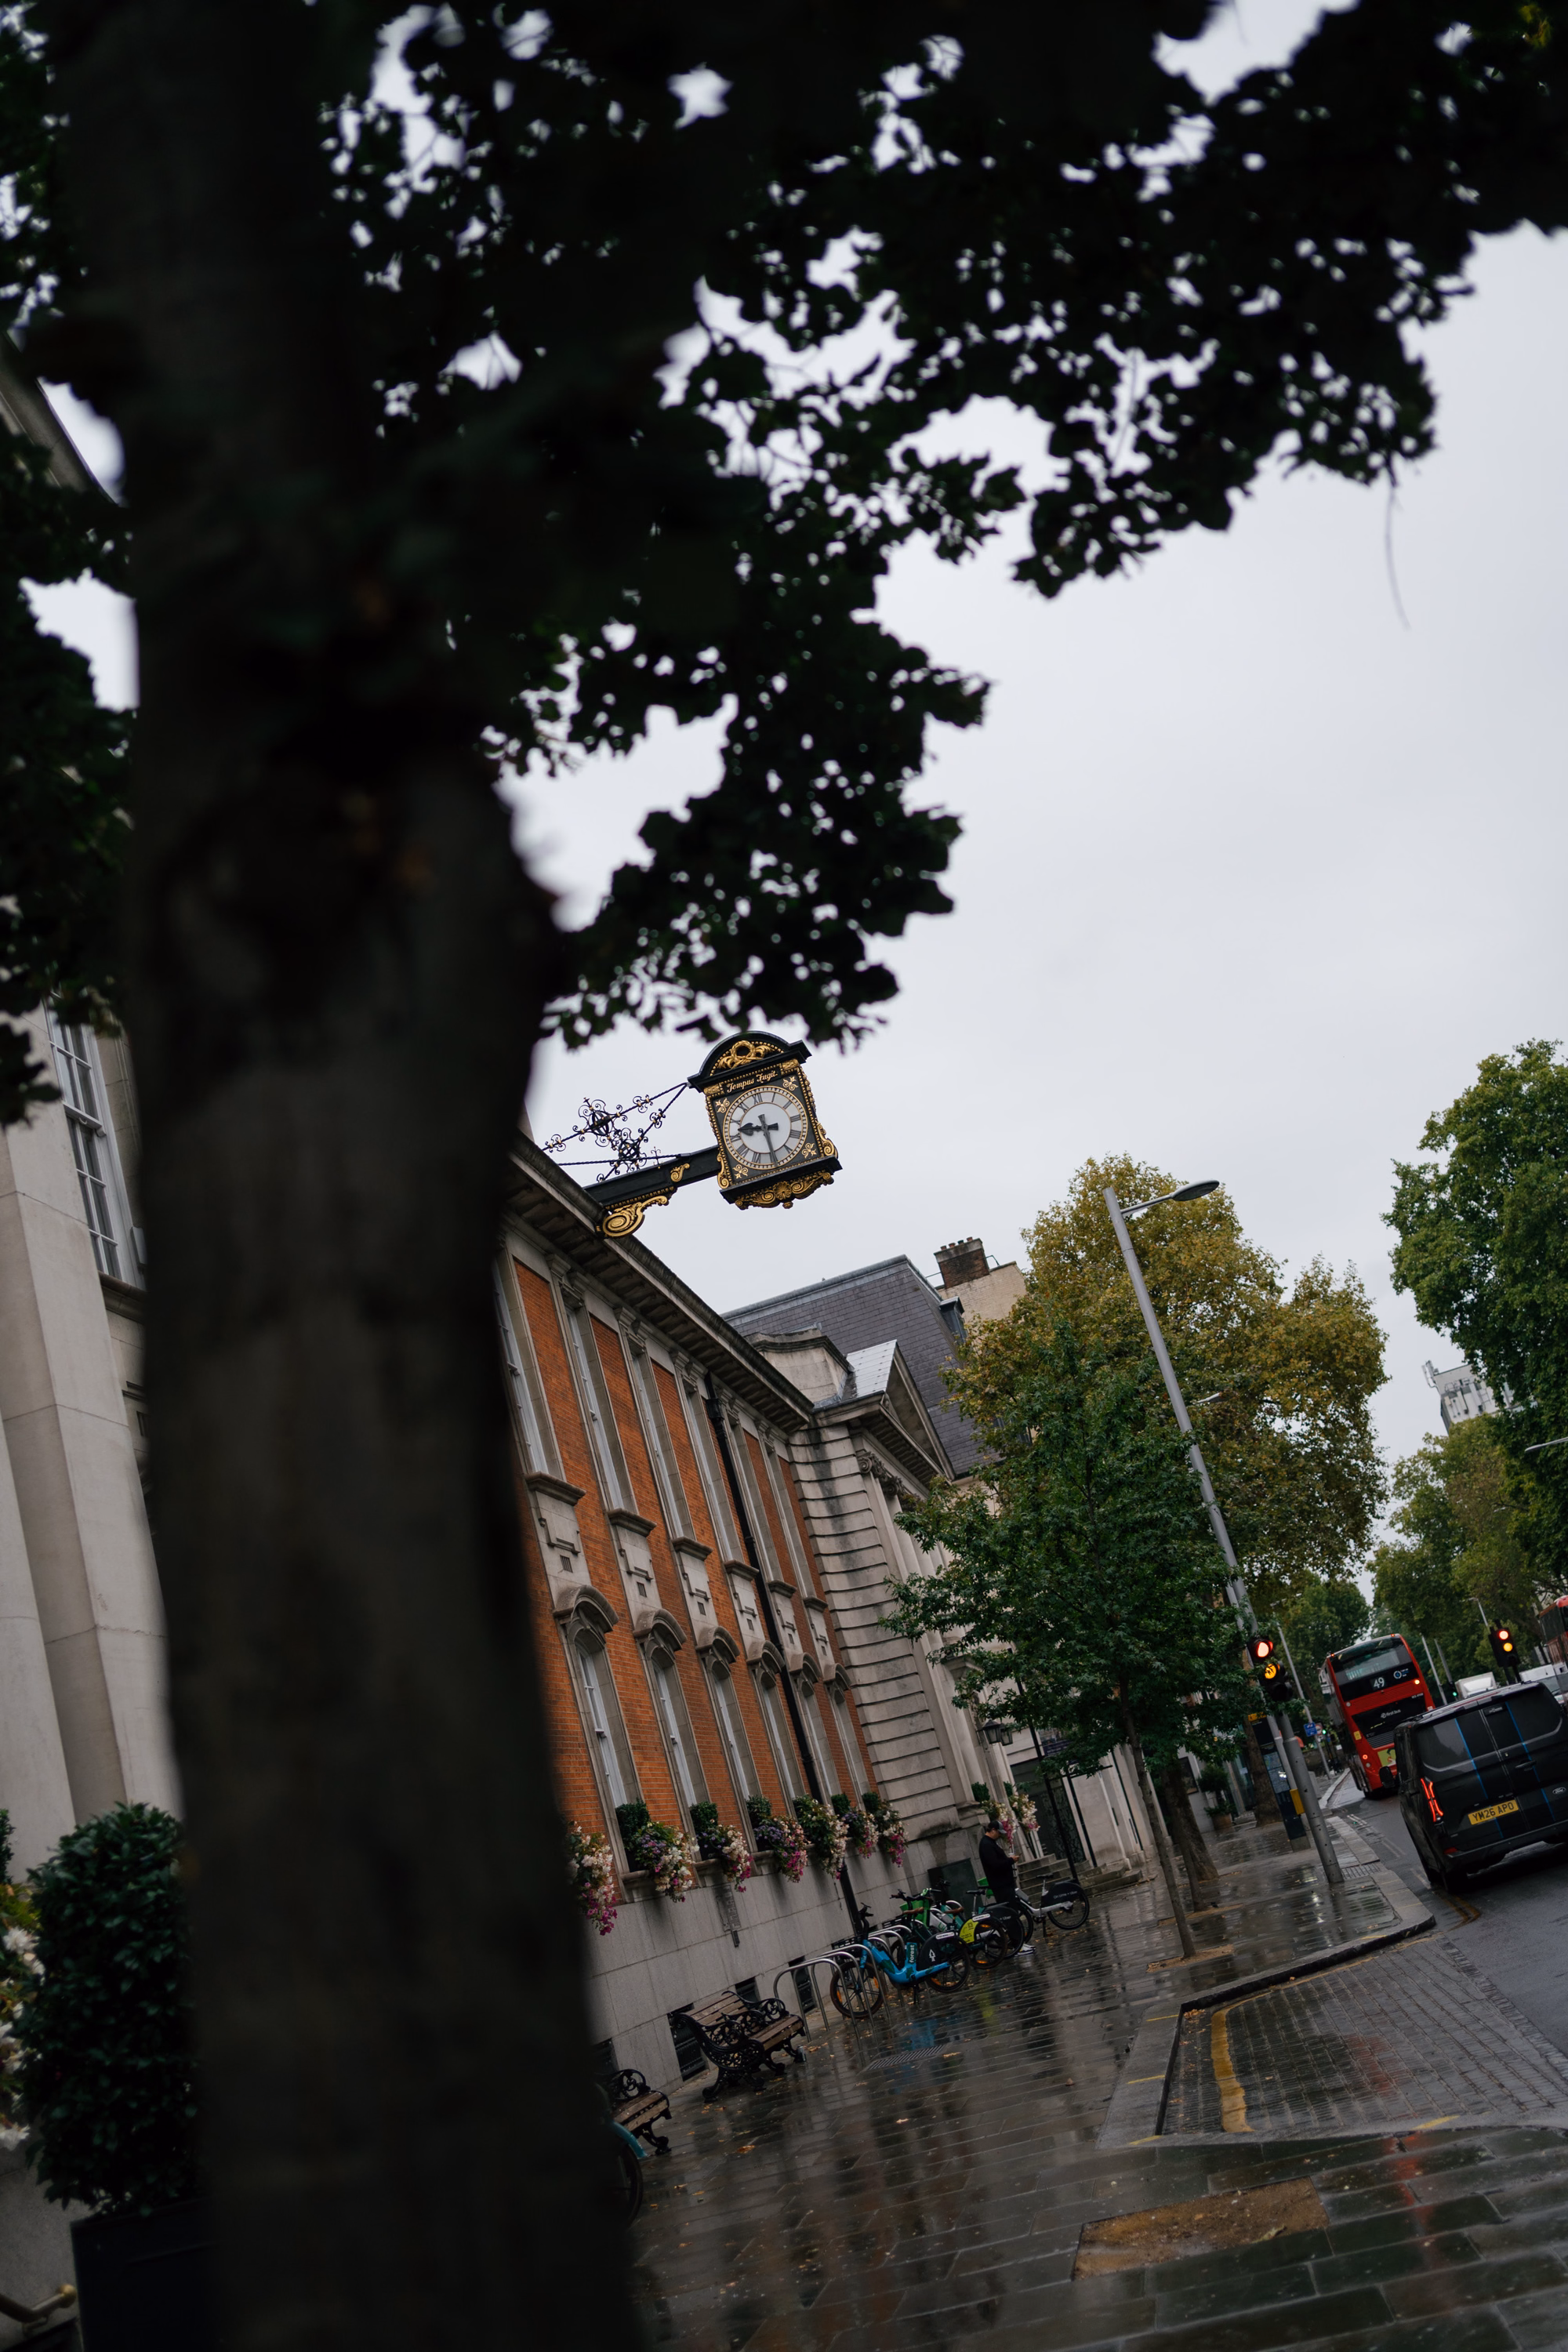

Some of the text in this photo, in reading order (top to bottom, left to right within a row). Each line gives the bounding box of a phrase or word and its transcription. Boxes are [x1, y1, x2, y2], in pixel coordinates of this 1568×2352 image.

[727, 1070, 778, 1093] Tempus Fugit
[752, 1093, 763, 1105] XII
[1374, 1677, 1385, 1689] 49
[1497, 1802, 1514, 1814] APO
